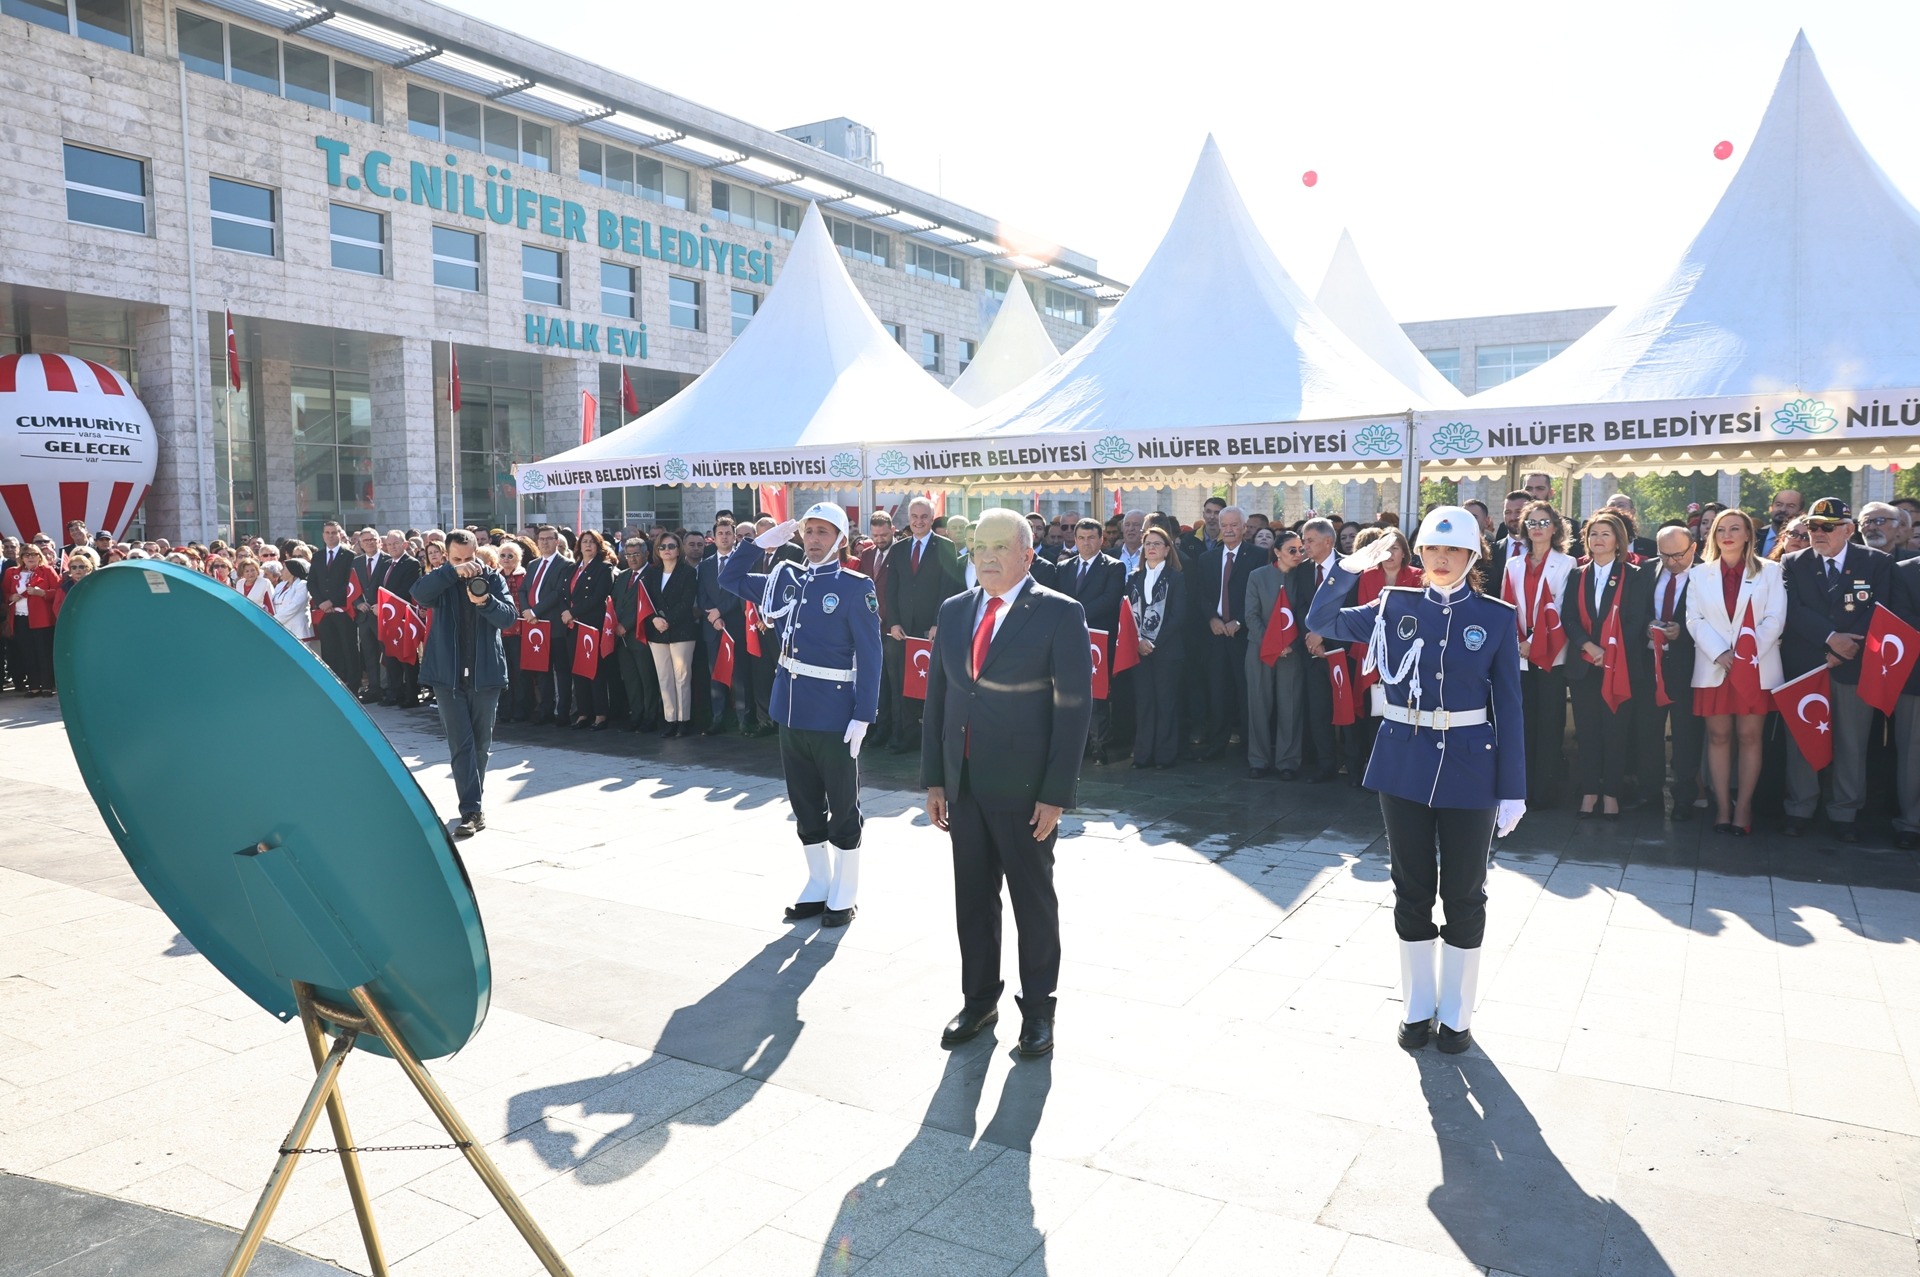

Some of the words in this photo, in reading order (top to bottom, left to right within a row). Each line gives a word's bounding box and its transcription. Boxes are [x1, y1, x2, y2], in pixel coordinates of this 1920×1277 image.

[598, 209, 773, 286] BELEDİYESİ
[525, 313, 600, 353] HALK
[608, 323, 648, 359] EVİ
[16, 416, 141, 434] CUMHURİYET
[78, 431, 102, 439] varsa
[1488, 421, 1595, 448] NİLÜFER
[1603, 405, 1761, 442] BELEDİYESİ
[44, 440, 130, 455] GELECEK
[912, 449, 983, 471] NİLÜFER
[987, 441, 1087, 465] BELEDİYESİ
[1137, 436, 1221, 459] NİLÜFER
[1227, 429, 1346, 456] BELEDİYESİ
[546, 471, 593, 487] NİLÜFER
[596, 463, 661, 482] BELEDİYESİ
[692, 459, 746, 477] NİLÜFER
[749, 456, 826, 475] BELEDİYESİ
